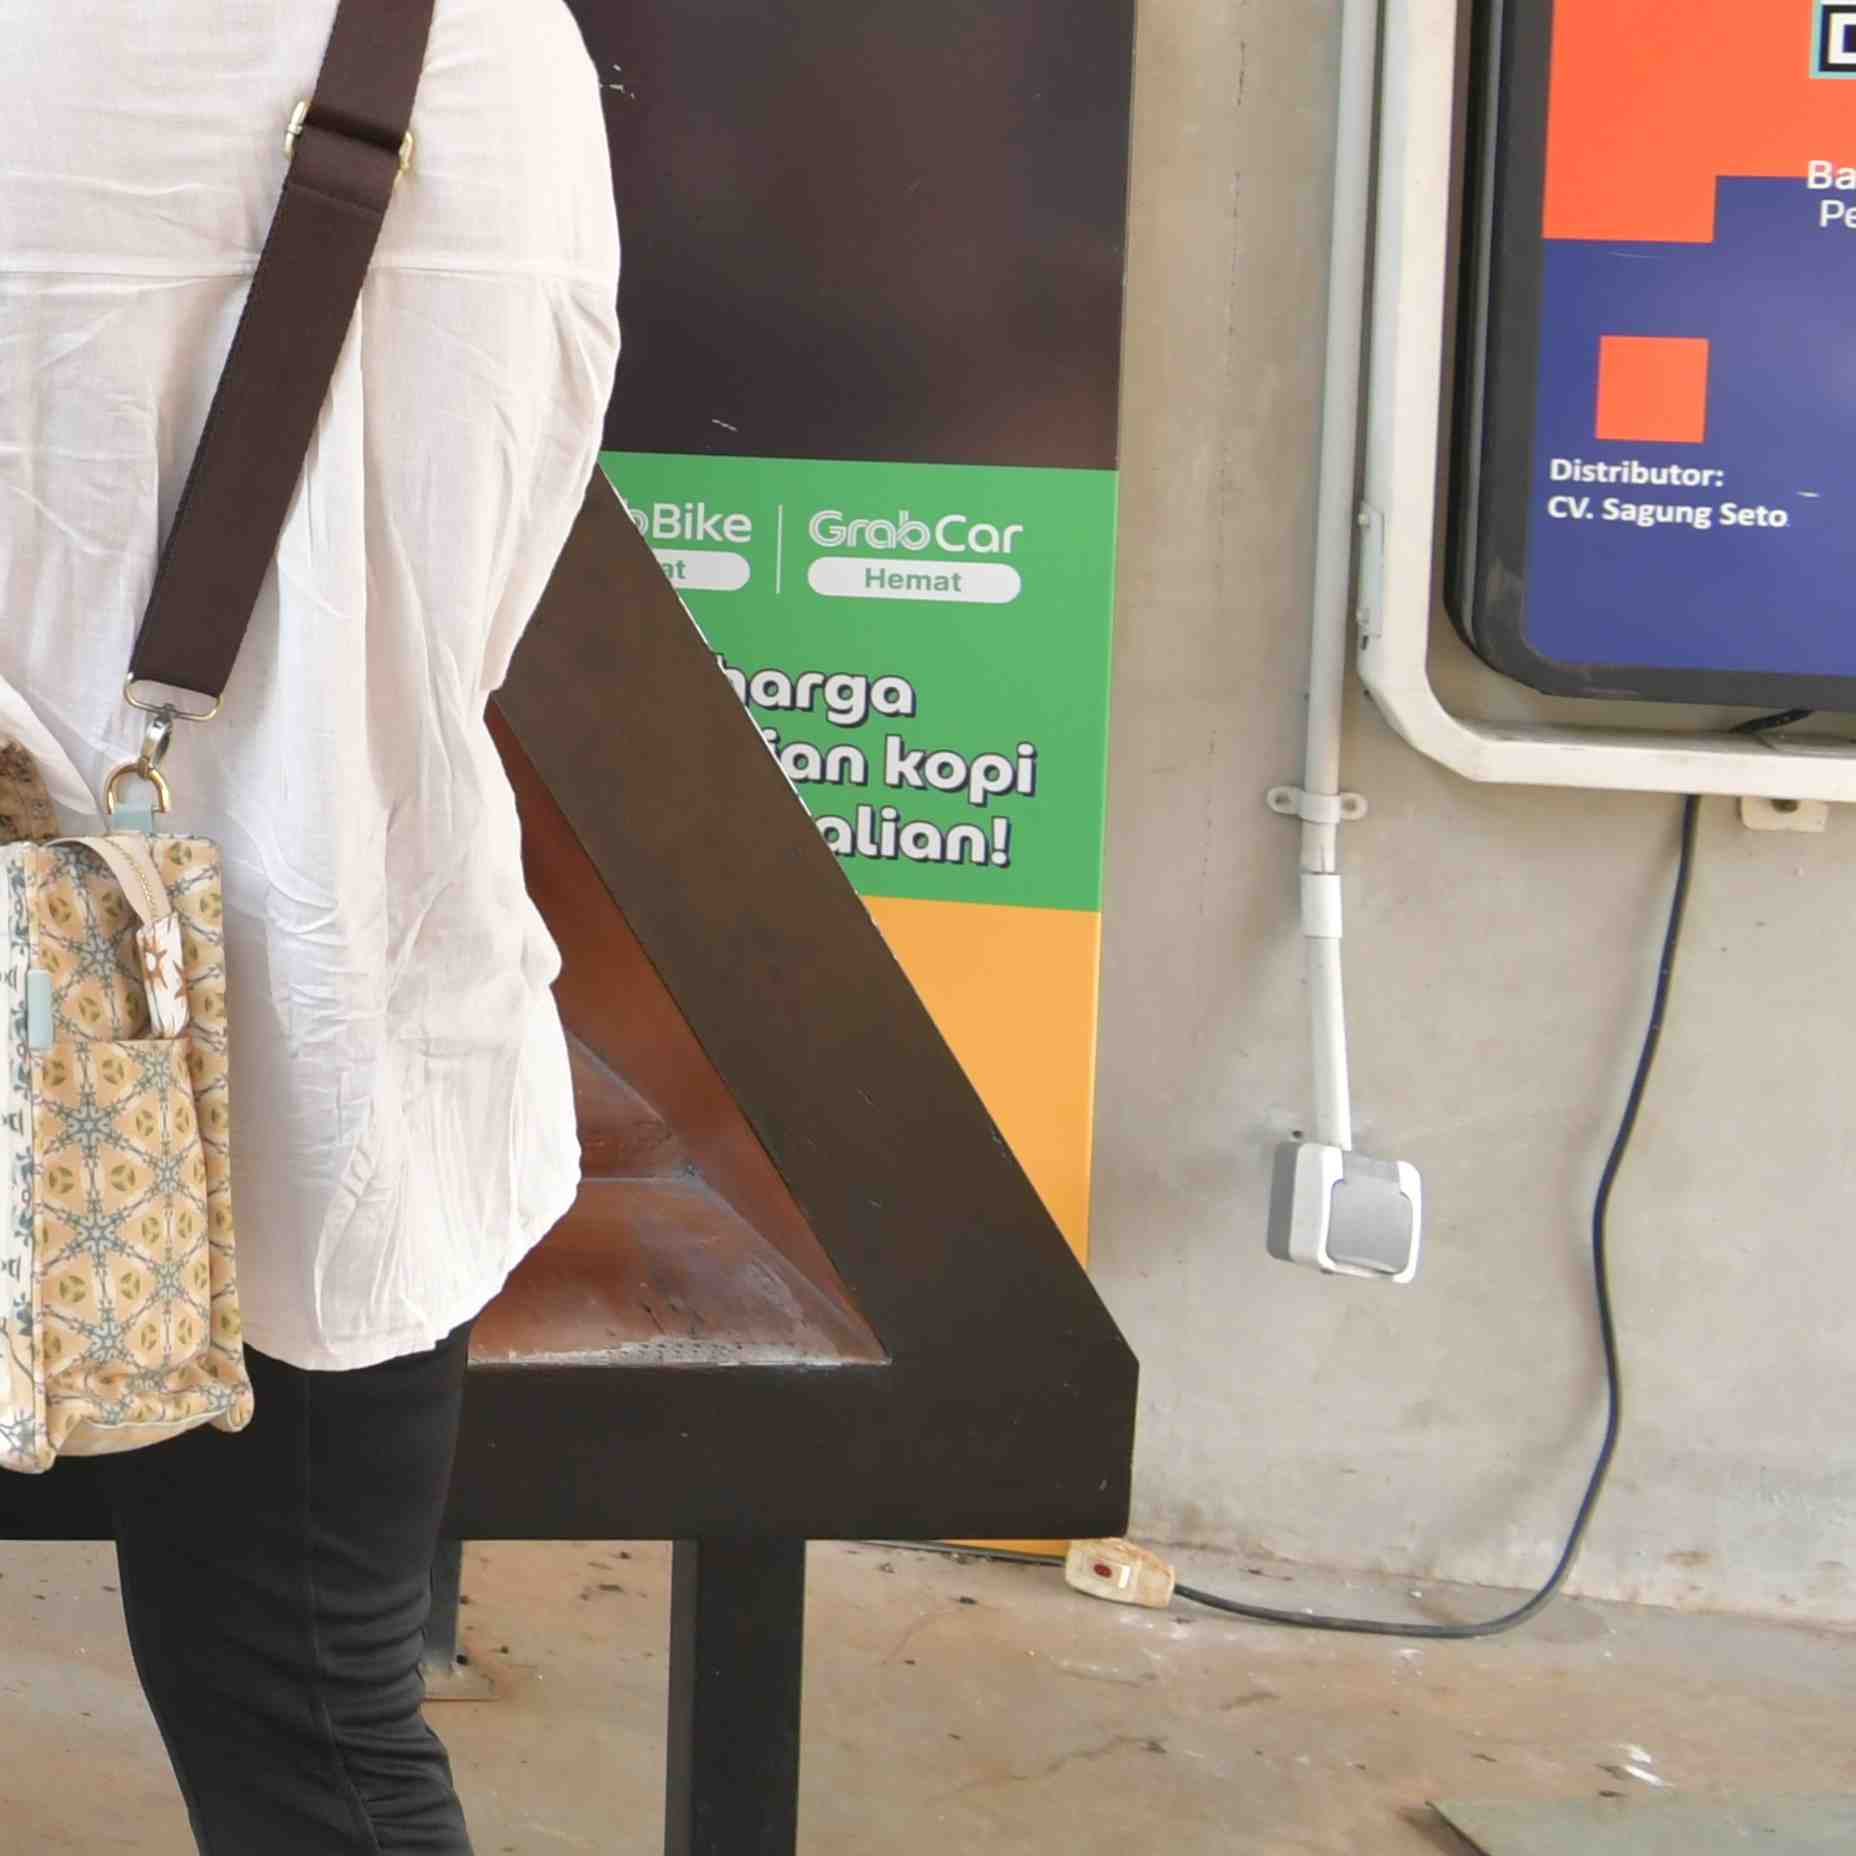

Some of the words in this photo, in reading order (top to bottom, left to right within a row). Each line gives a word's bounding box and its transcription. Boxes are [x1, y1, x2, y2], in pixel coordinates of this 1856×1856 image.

[1549, 457, 1725, 488] Distributor:
[1546, 495, 1594, 521] CV.
[1601, 498, 1713, 531] Sagung
[1719, 502, 1789, 529] Seto
[807, 508, 1024, 555] GrabCar
[864, 567, 962, 594] Hemat
[883, 732, 1037, 806] kopi
